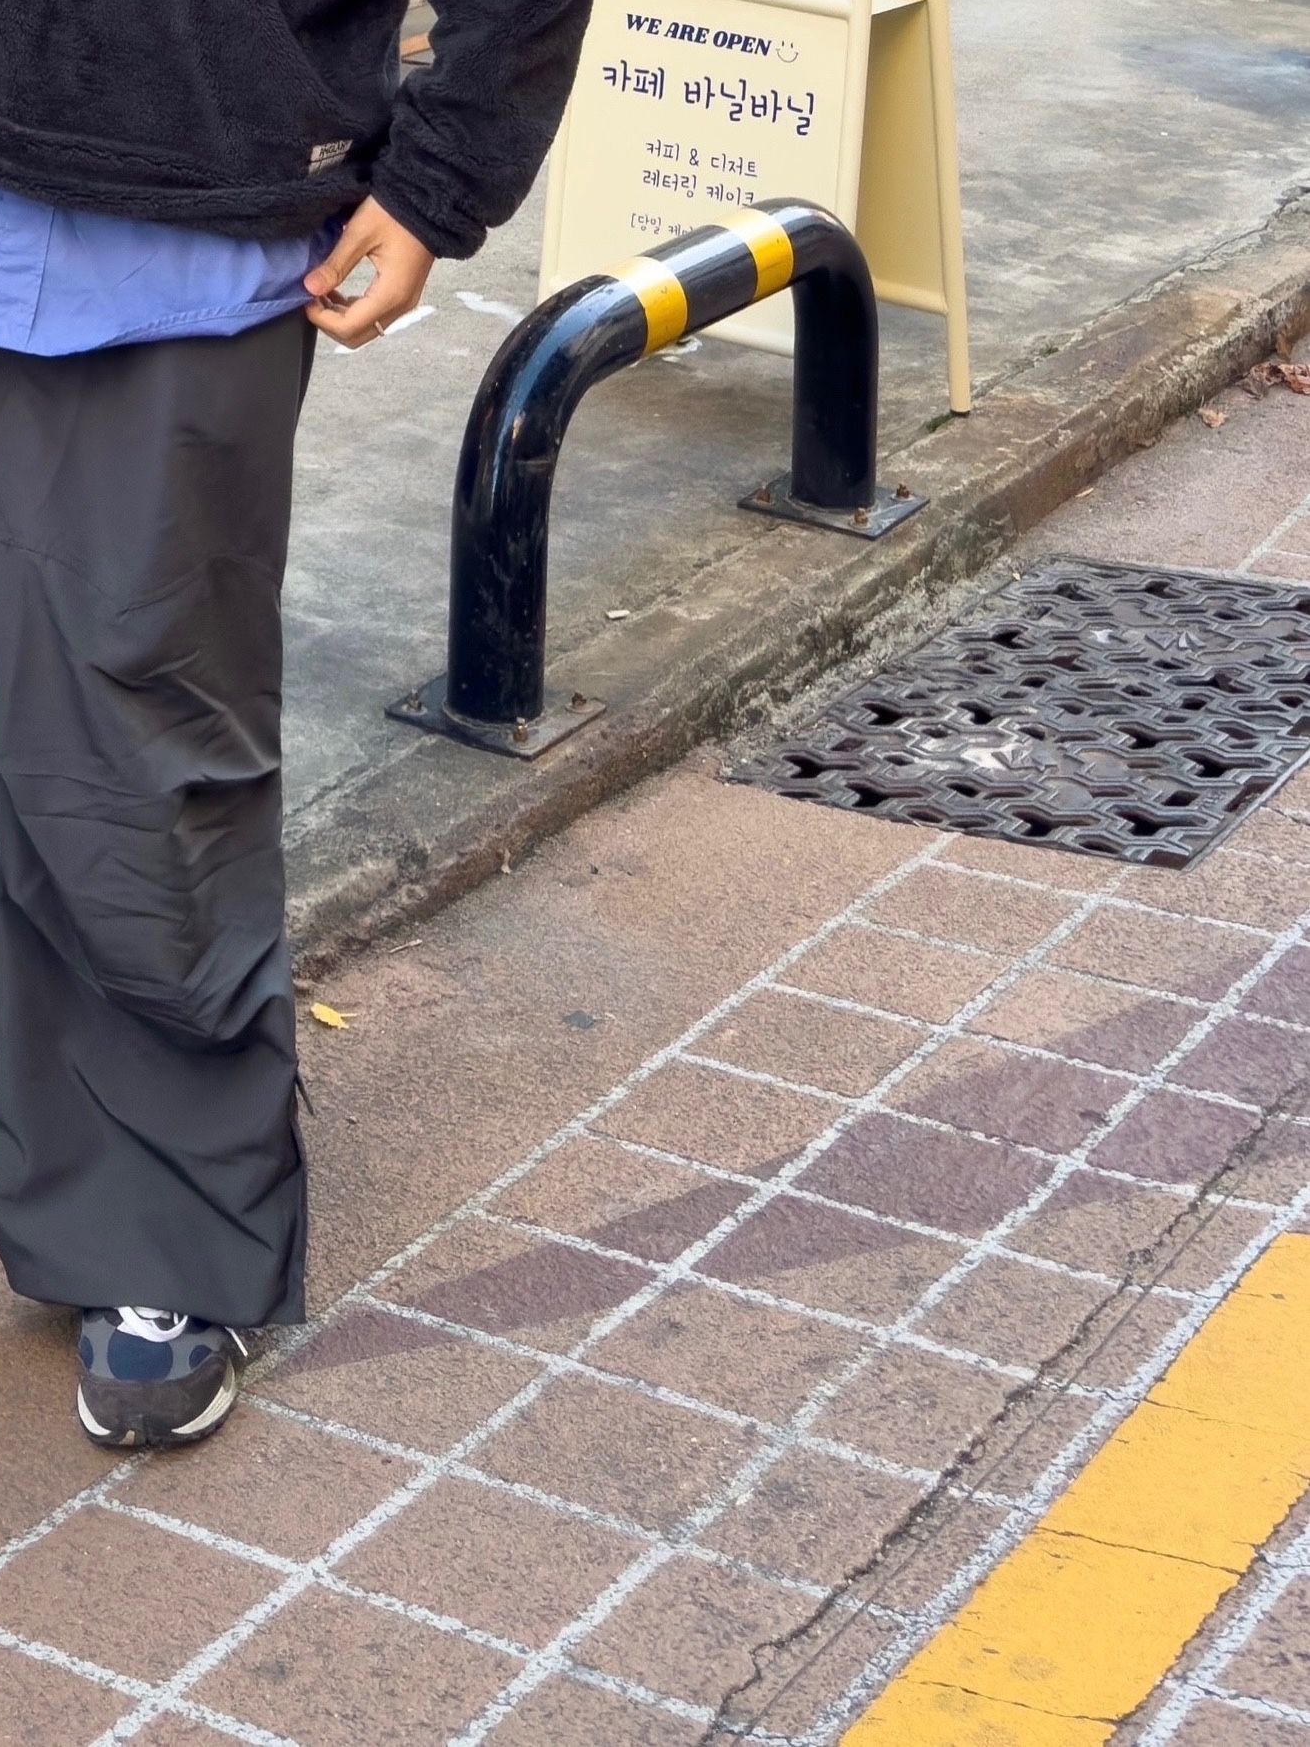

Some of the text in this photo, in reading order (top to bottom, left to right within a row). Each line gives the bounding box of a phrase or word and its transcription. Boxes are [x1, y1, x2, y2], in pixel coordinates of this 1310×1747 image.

[626, 13, 772, 57] WE ARE OPEN
[602, 59, 815, 136] 카페 바닐바닐
[645, 139, 758, 178] 커피 & 디저트
[642, 169, 755, 209] 레터링 케이크
